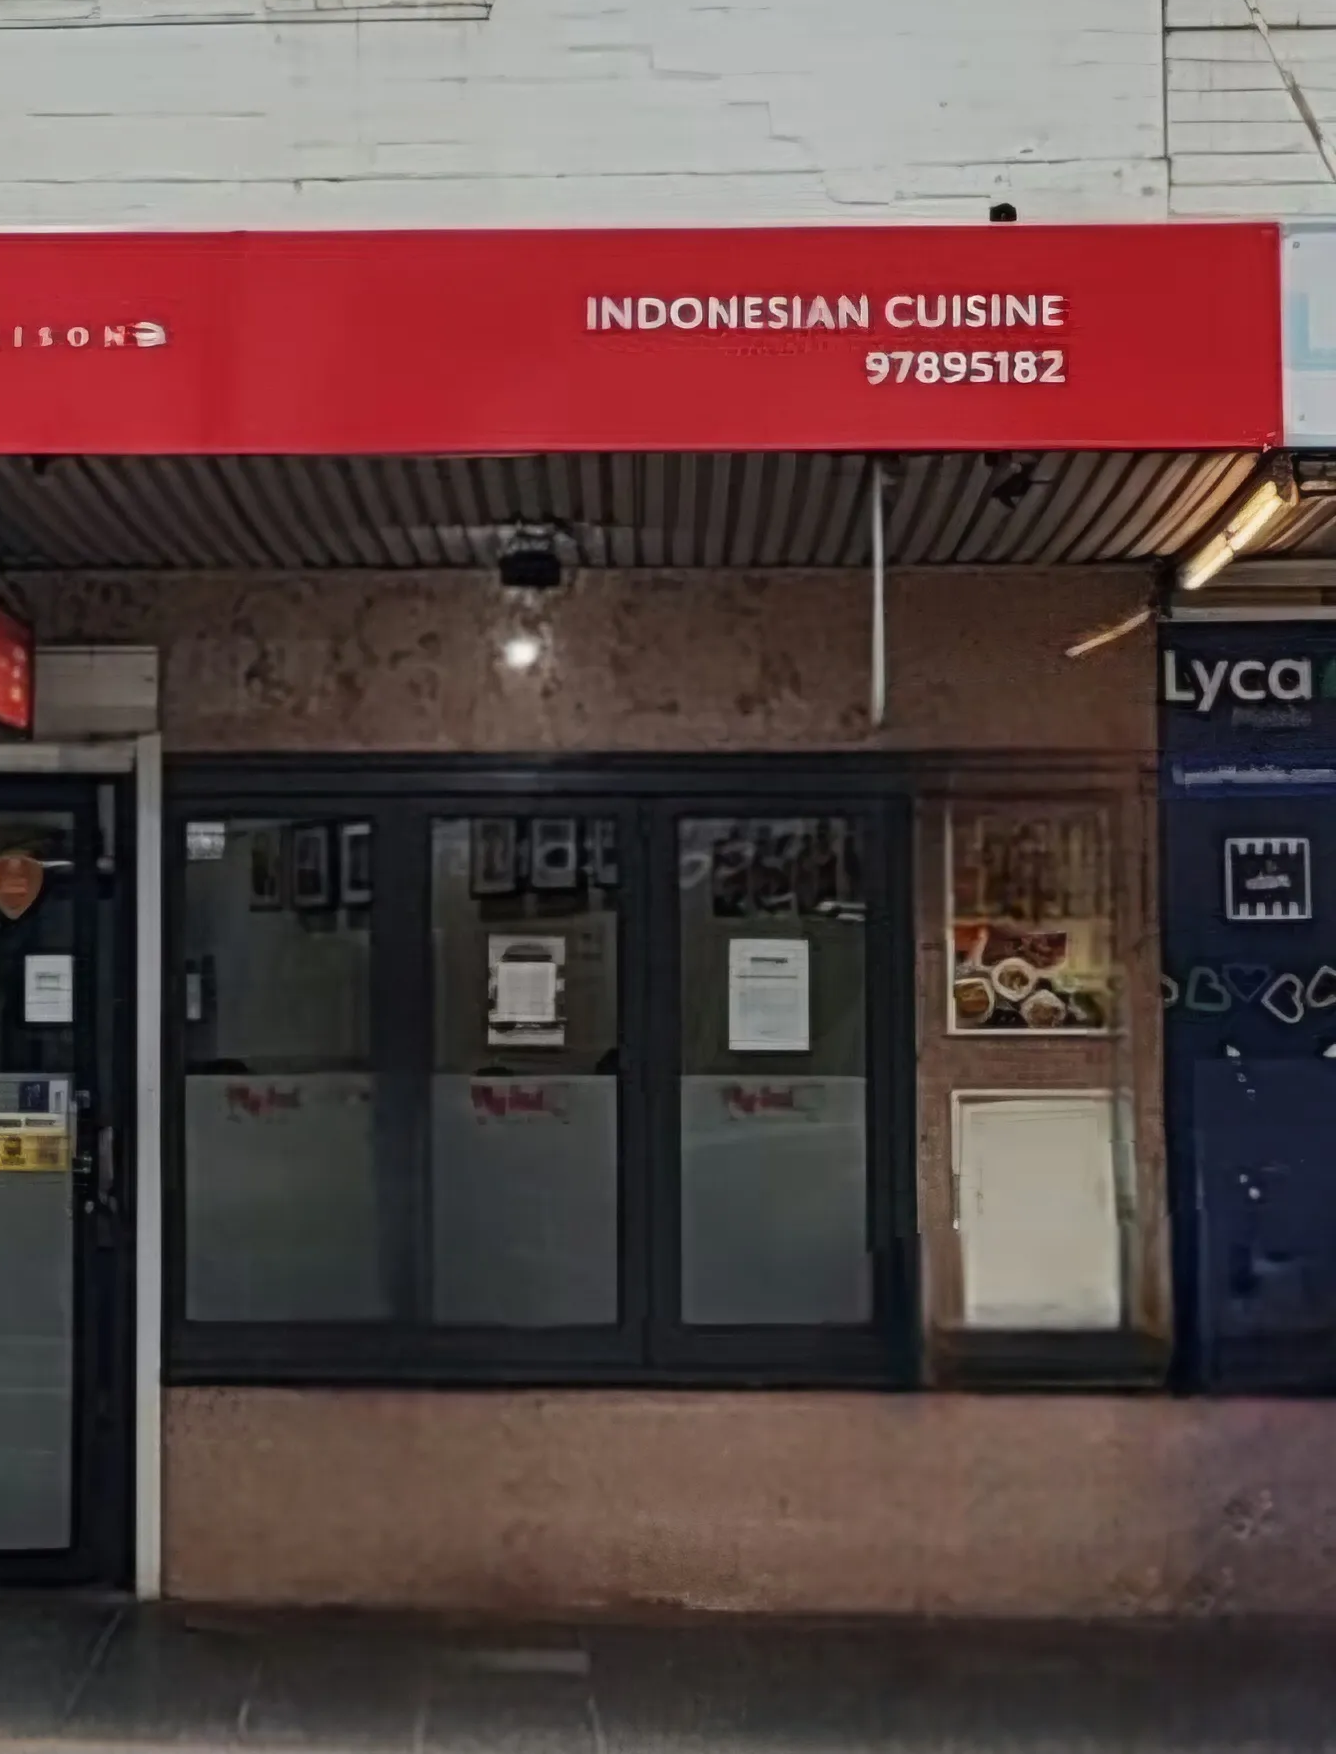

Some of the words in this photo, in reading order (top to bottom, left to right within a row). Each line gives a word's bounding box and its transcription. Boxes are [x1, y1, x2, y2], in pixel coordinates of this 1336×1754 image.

[586, 295, 869, 329] INDONESIAN
[884, 294, 1065, 328] CUISINE
[865, 350, 1066, 385] 97895182
[1165, 649, 1312, 712] Lyca
